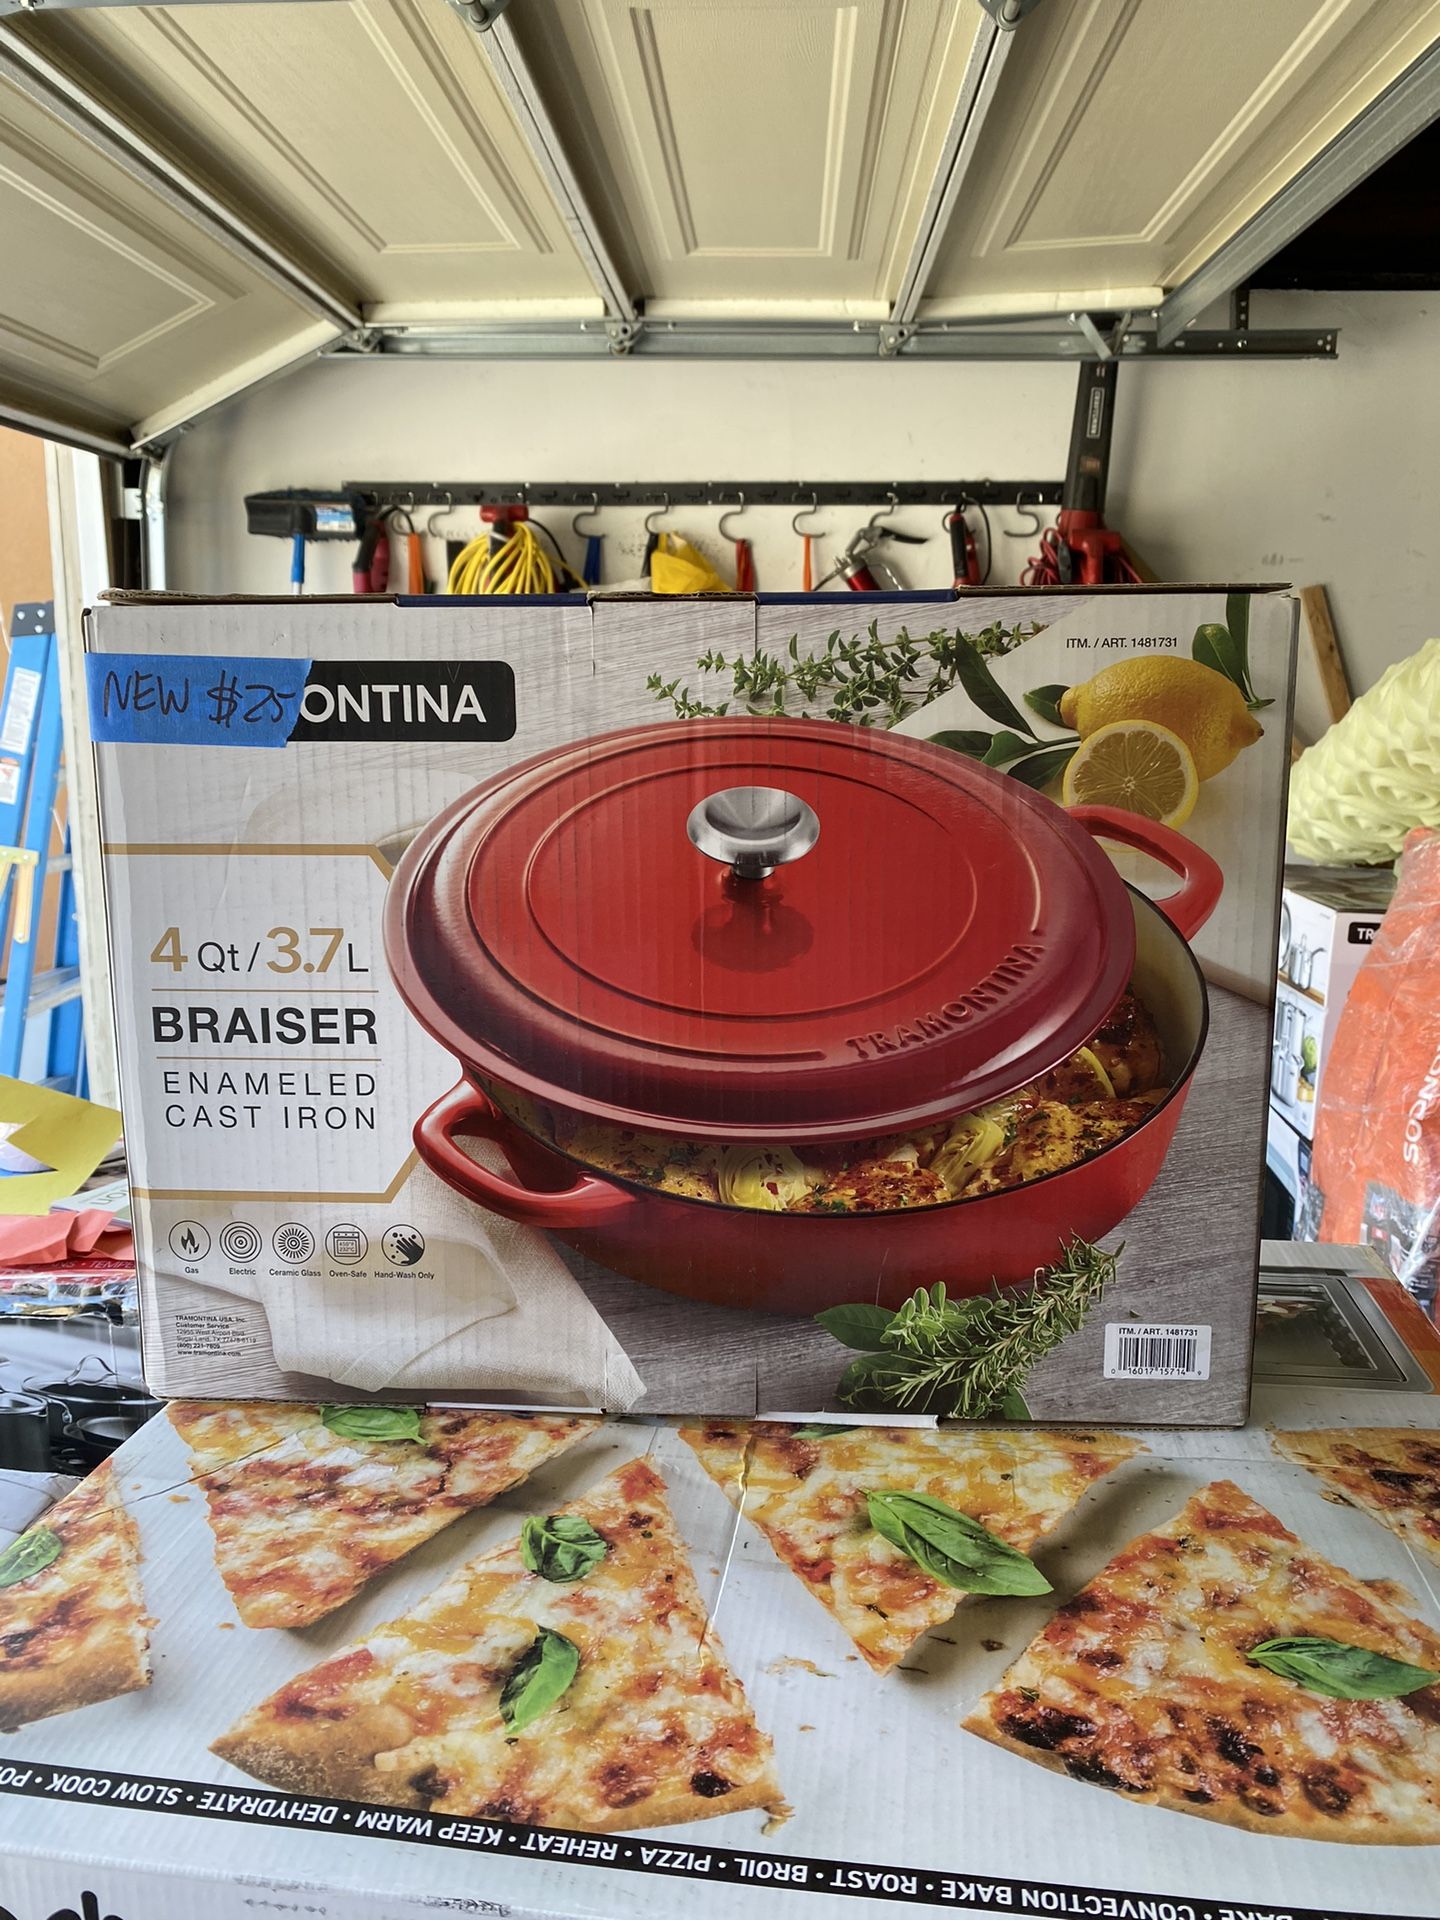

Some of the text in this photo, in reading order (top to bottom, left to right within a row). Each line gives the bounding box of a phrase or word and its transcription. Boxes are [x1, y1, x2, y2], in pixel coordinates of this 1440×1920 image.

[1066, 638, 1091, 648] ITM.
[1101, 637, 1127, 648] ART.
[1131, 637, 1177, 648] 1481731
[104, 670, 189, 717] NEW
[206, 669, 296, 728] $25
[300, 683, 487, 723] ONTINA
[150, 927, 188, 972] 4
[198, 941, 240, 973] Qt
[845, 944, 1045, 1059] TRAMONTINA
[152, 1006, 378, 1045] BRAISER
[163, 1071, 376, 1096] ENAMELED
[165, 1104, 375, 1130] CAST IRON
[184, 1266, 199, 1274] Gas
[229, 1267, 256, 1275] Electric
[269, 1268, 321, 1277] Ceramic Glass
[329, 1270, 367, 1278] Oven-Safe
[374, 1271, 435, 1280] Hand-Wash Only
[44, 1773, 112, 1797] COOK
[111, 1782, 184, 1806] SLOW
[196, 1791, 338, 1824] DEHYDRATE
[355, 1810, 432, 1836] WARM
[438, 1823, 504, 1846] KEEP
[520, 1833, 618, 1860] REHEAT
[641, 1847, 711, 1873] PIZZA
[734, 1858, 808, 1883] BROIL
[830, 1869, 918, 1894] ROAST
[941, 1880, 1012, 1905] BAKE
[1022, 1889, 1195, 1920] CONVECTION
